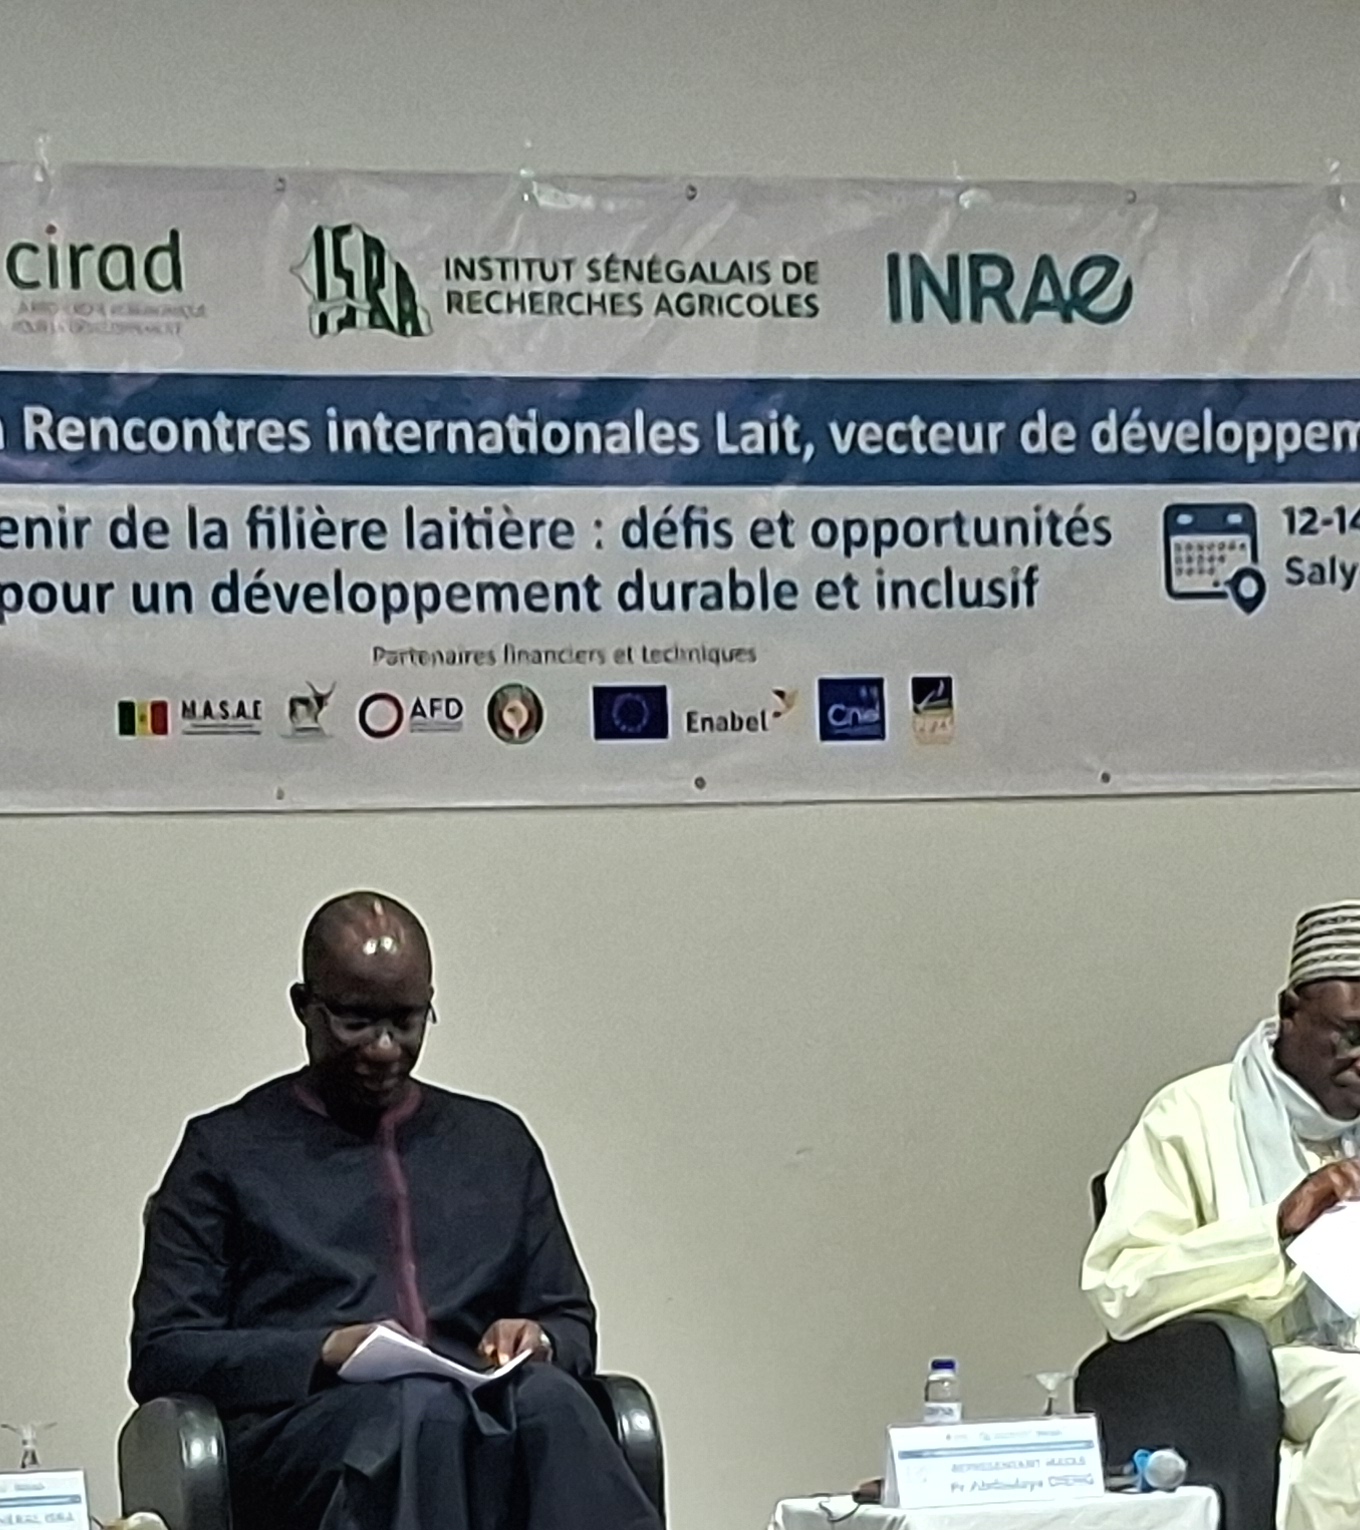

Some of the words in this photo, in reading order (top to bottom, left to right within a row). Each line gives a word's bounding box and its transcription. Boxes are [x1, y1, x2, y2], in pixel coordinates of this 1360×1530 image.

[6, 224, 183, 293] cirad
[444, 255, 575, 283] INSTITUT
[586, 253, 772, 286] SÉNÉGALAIS
[782, 260, 819, 286] DE
[446, 289, 643, 318] RECHERCHES
[654, 291, 820, 319] AGRICOLES
[23, 405, 311, 454] Rencontres
[326, 406, 700, 455] internationales
[716, 408, 815, 463] Lait,
[828, 413, 1003, 455] vecteur
[1020, 408, 1077, 454] de
[109, 504, 170, 550] de
[188, 504, 228, 550] la
[245, 504, 388, 551] filière
[405, 504, 575, 551] laitière
[621, 504, 733, 550] défis
[749, 510, 796, 550] et
[811, 503, 1112, 559] opportunités
[132, 581, 193, 614] un
[211, 567, 602, 625] développement
[617, 566, 799, 612] durable
[815, 572, 860, 611] et
[876, 564, 1039, 610] inclusif
[373, 646, 497, 666] Partenaires
[503, 643, 606, 665] financiers
[614, 646, 633, 664] et
[641, 645, 757, 666] techniques
[410, 696, 464, 720] AFD
[686, 709, 768, 734] Enabel
